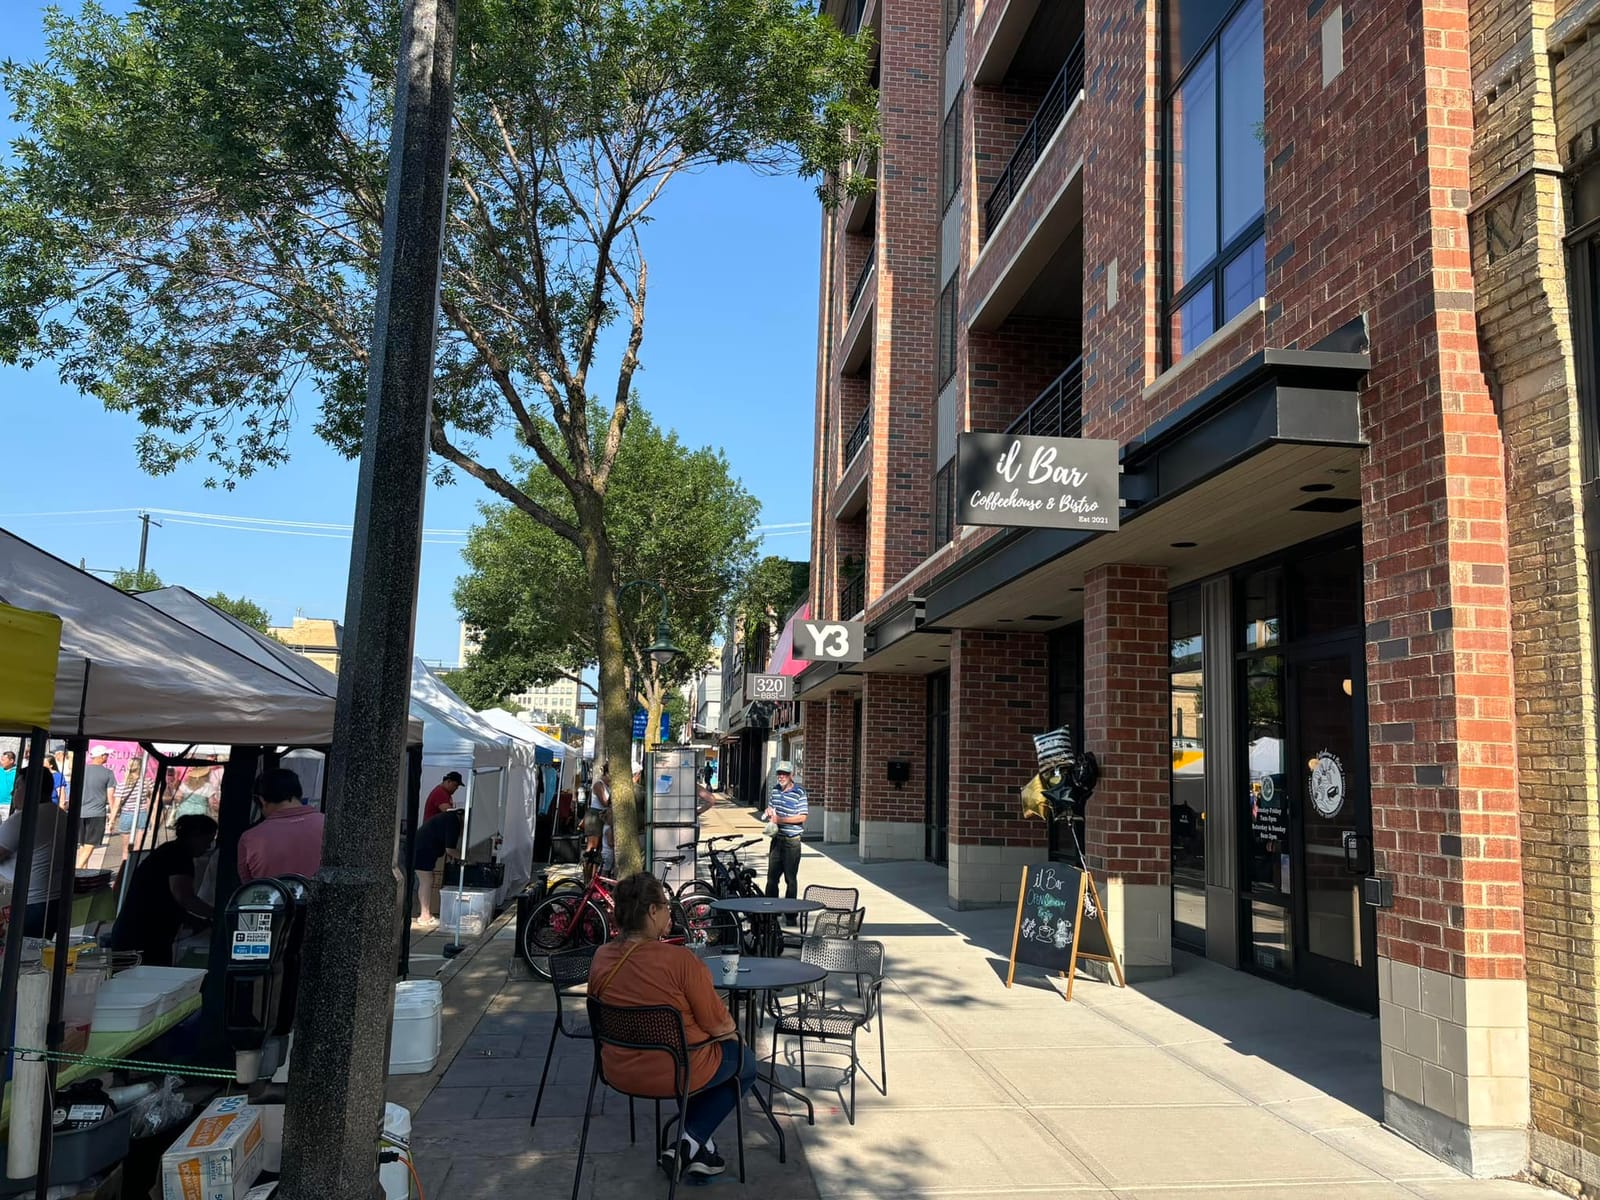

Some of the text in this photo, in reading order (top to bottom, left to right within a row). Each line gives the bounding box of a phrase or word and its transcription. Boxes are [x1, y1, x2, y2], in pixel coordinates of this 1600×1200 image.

[996, 440, 1088, 488] il Bar
[969, 488, 1100, 513] Coffeehouse & Bistro
[1078, 515, 1109, 524] Est 2021
[806, 624, 850, 658] Y3
[757, 678, 783, 692] 320
[1045, 868, 1065, 891] Bar
